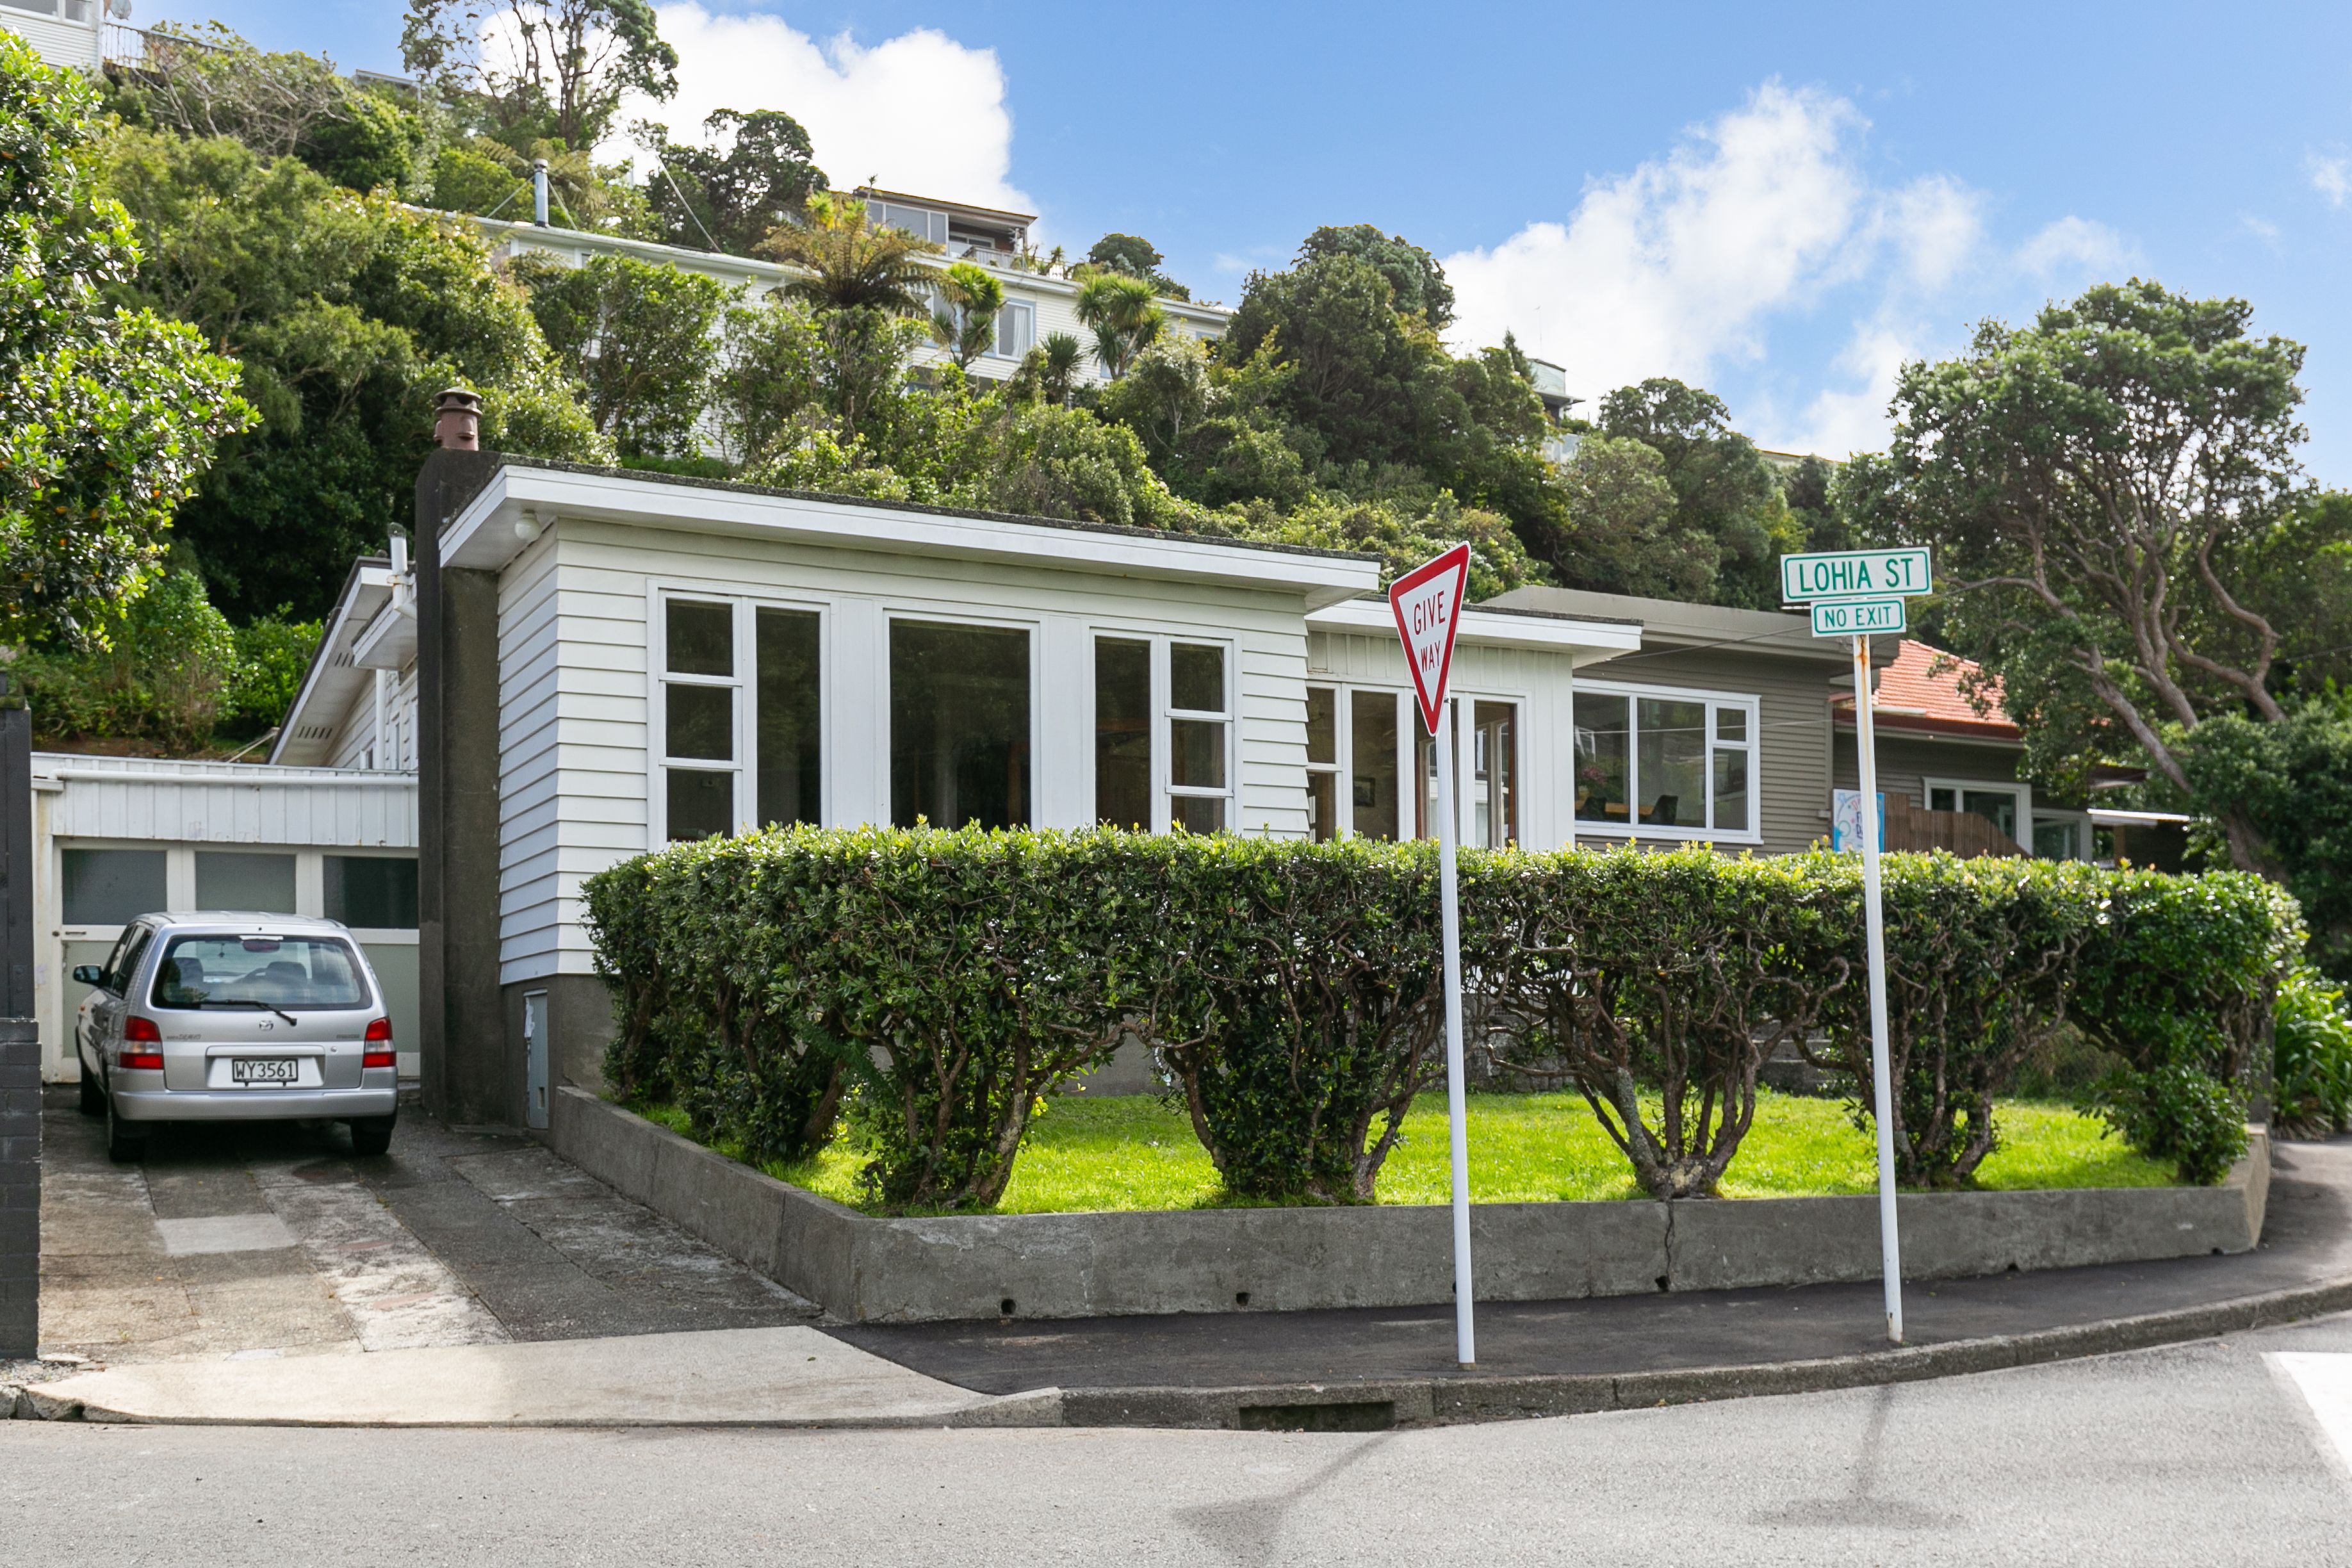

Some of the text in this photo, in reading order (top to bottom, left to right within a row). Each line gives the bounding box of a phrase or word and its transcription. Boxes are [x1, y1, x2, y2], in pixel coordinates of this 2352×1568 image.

[1799, 558, 1914, 592] LOHIA ST
[1414, 591, 1446, 635] GIVE
[1824, 606, 1892, 628] NO EXIT
[1420, 641, 1441, 673] WAY
[235, 1061, 294, 1078] WY3561
